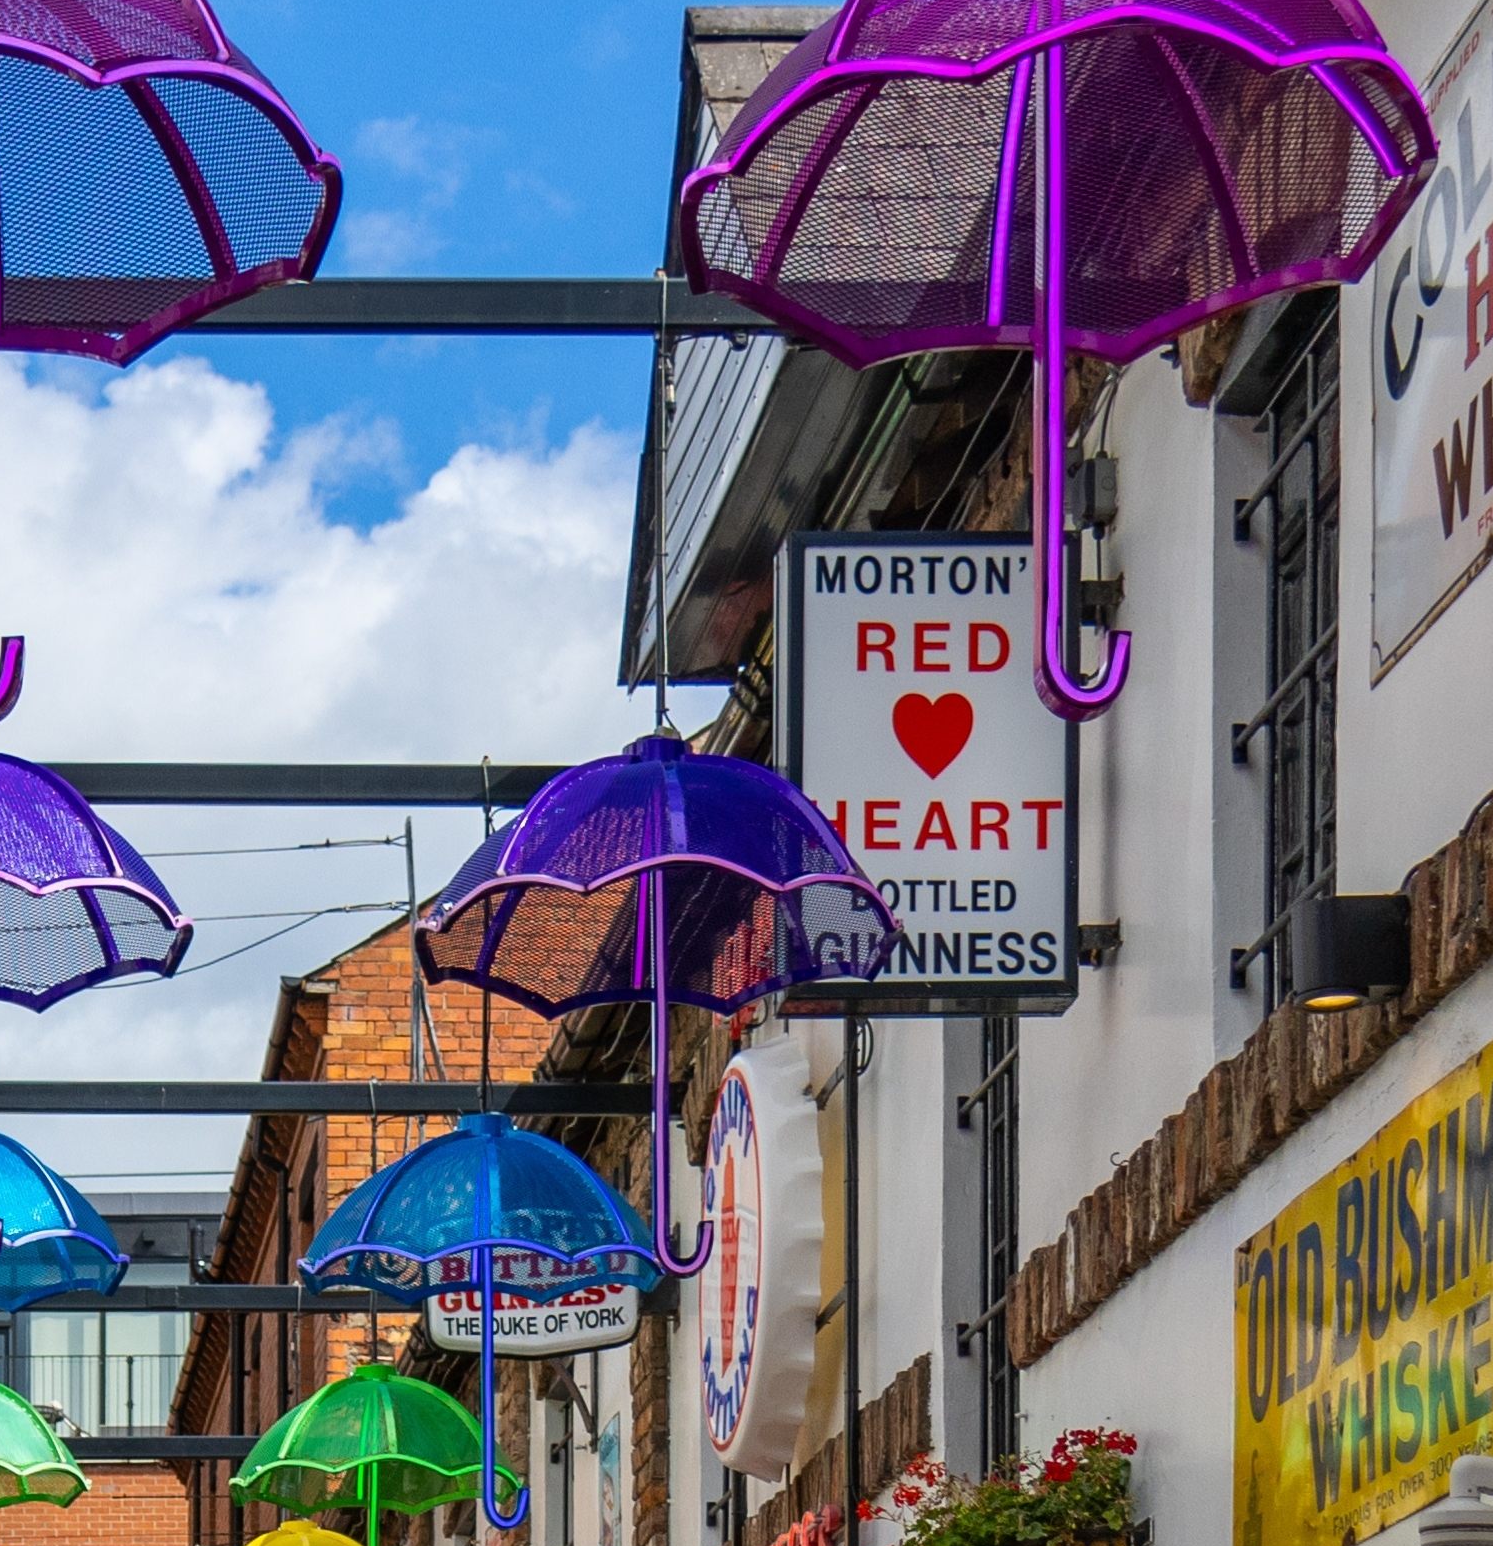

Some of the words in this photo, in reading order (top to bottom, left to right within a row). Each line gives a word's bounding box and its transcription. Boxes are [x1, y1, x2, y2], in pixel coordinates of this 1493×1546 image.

[1424, 29, 1481, 118] SUPPLIED
[815, 554, 1028, 596] MORTON'
[856, 621, 1010, 673] RED
[811, 799, 1063, 852] HEART
[444, 1316, 480, 1337] THE
[544, 1315, 570, 1335] OF
[575, 1306, 625, 1330] YORK
[1332, 1501, 1372, 1537] FAMOUS
[1374, 1487, 1397, 1513] FOR
[1398, 1471, 1426, 1500] OVER
[1428, 1455, 1453, 1483] 300
